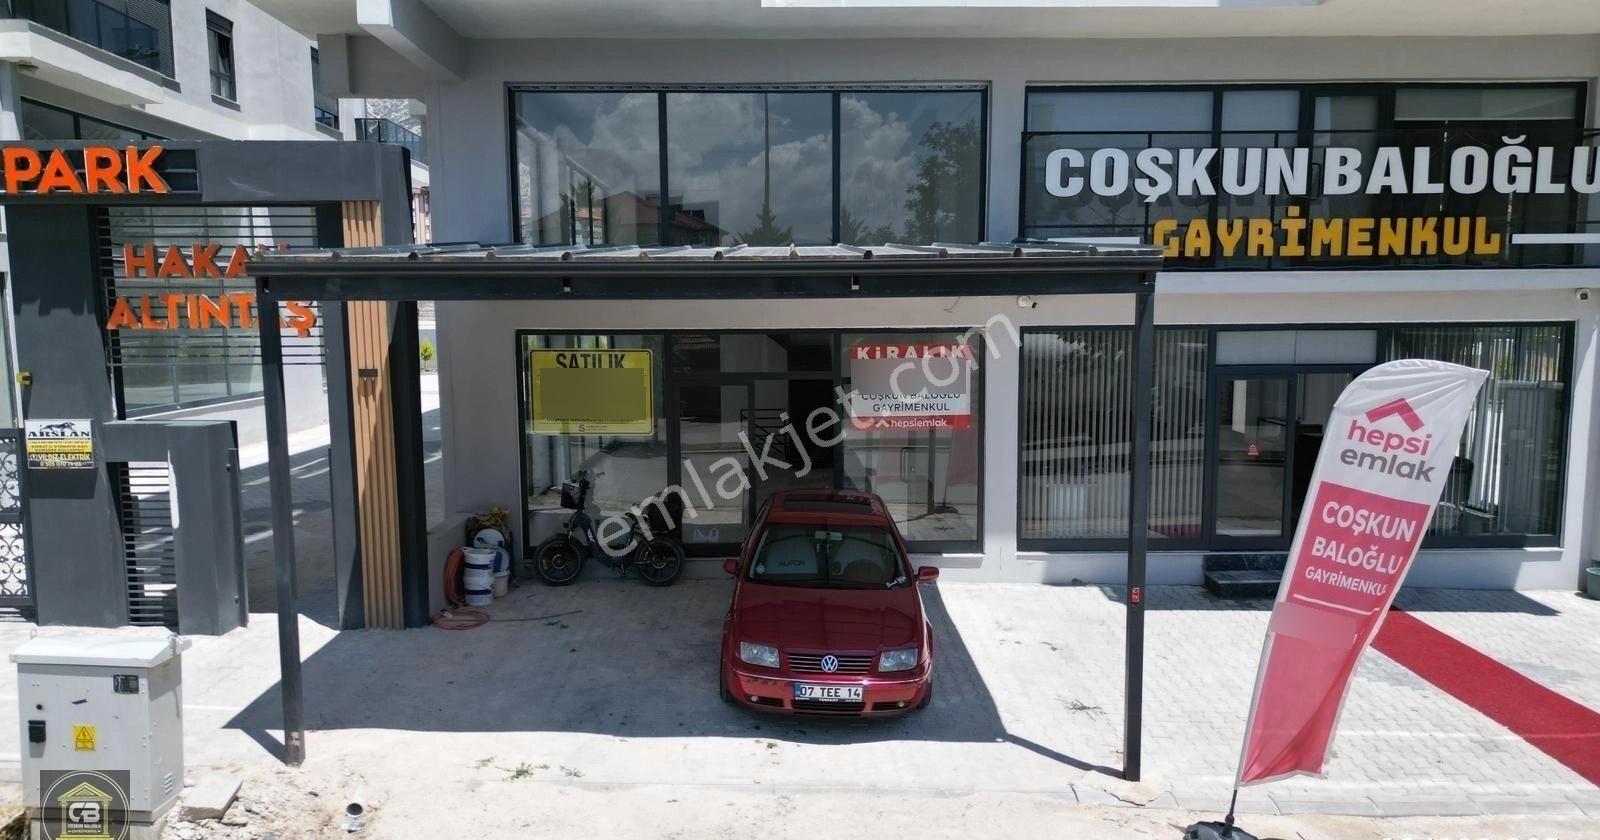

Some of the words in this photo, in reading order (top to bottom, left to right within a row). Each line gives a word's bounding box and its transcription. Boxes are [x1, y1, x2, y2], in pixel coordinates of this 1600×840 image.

[2, 145, 170, 194] PARK
[1044, 146, 1309, 202] COŞKUN
[1323, 134, 1600, 196] BALOĞLU
[1153, 206, 1501, 258] GAYRİMENKUL
[123, 243, 288, 279] HAKA
[106, 291, 317, 338] ALTINTŞ
[872, 402, 950, 412] GAYRİMENKUL
[890, 417, 948, 429] hepsiemlak
[1347, 419, 1433, 456] hepsi
[1340, 448, 1437, 483] emlak
[1321, 501, 1417, 543] COŞKUN
[1311, 536, 1403, 576] BALOĞLU
[800, 686, 814, 697] 07
[819, 687, 841, 698] TEE
[847, 688, 861, 698] 14
